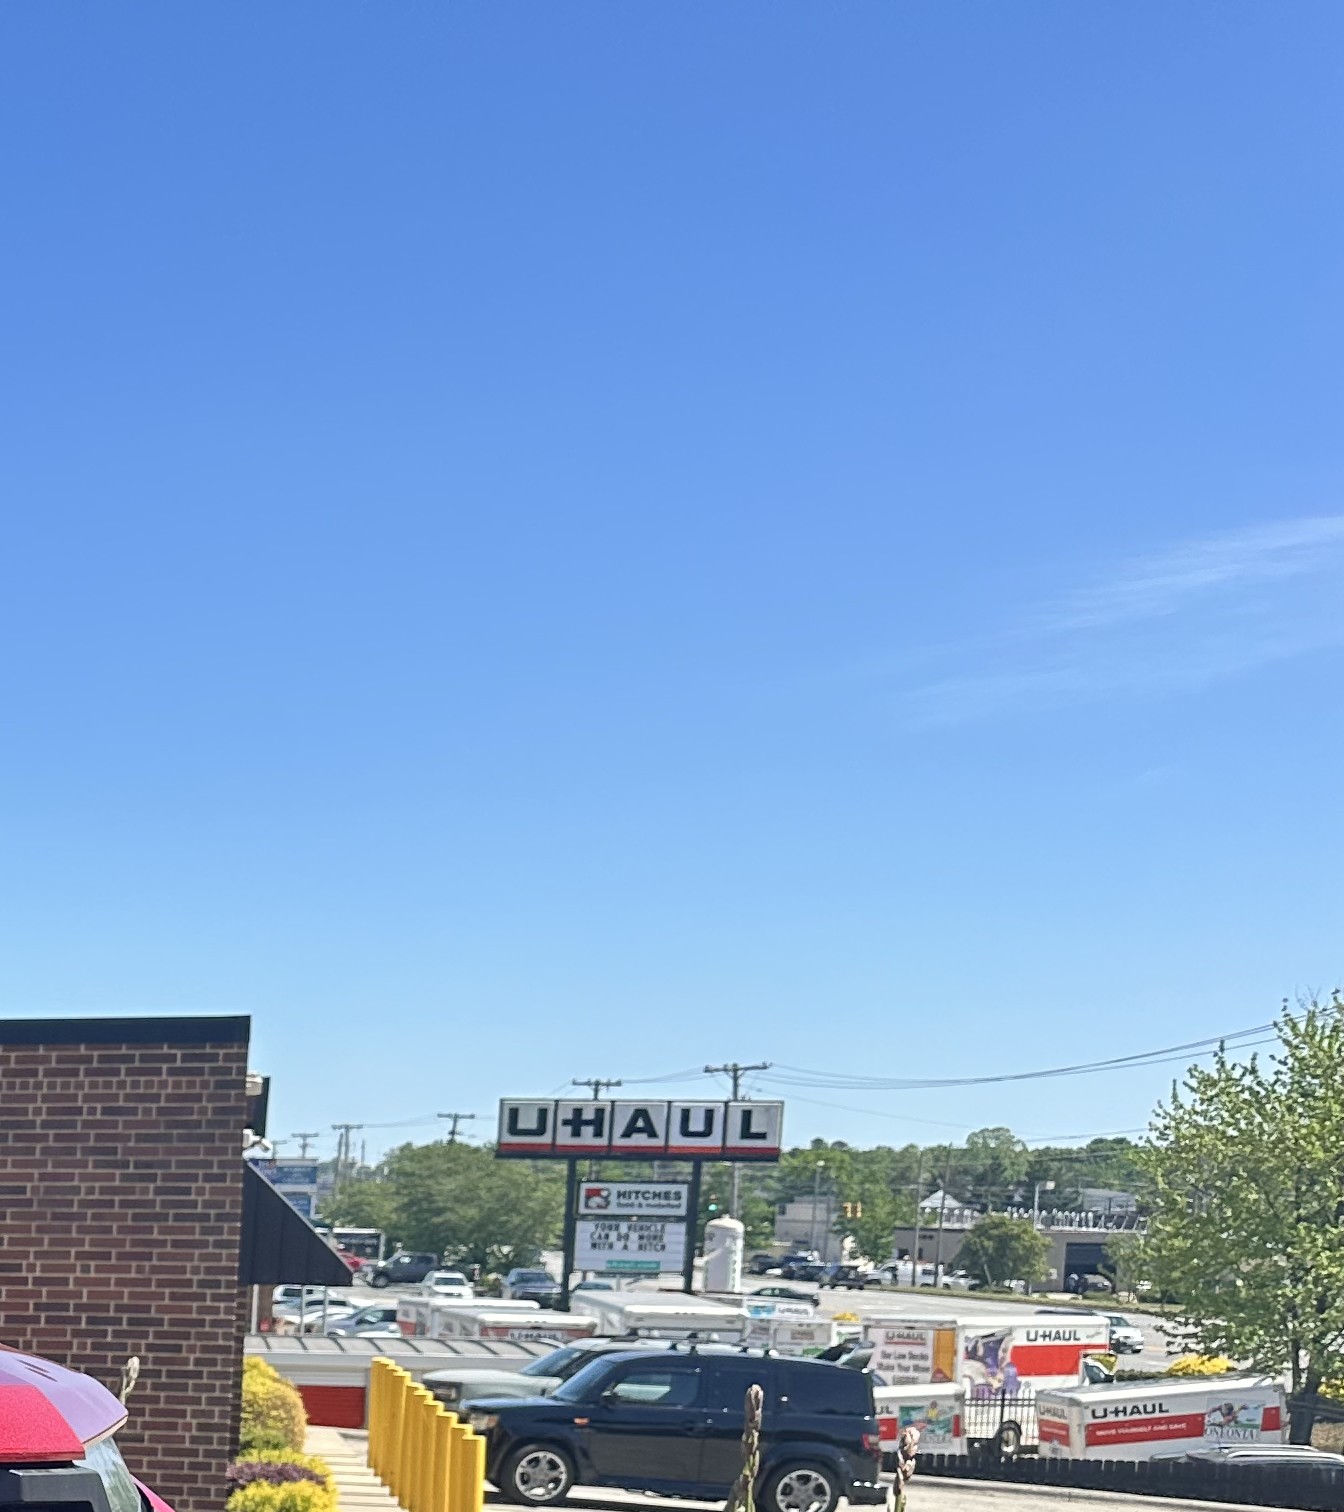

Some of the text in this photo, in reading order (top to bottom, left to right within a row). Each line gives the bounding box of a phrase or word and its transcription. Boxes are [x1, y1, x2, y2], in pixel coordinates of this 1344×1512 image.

[616, 1189, 682, 1201] HITCHES
[594, 1222, 620, 1232] YOUR
[590, 1232, 610, 1241] CAN
[590, 1242, 666, 1252] WITH A HITCH
[1091, 1402, 1170, 1420] U-HAUL
